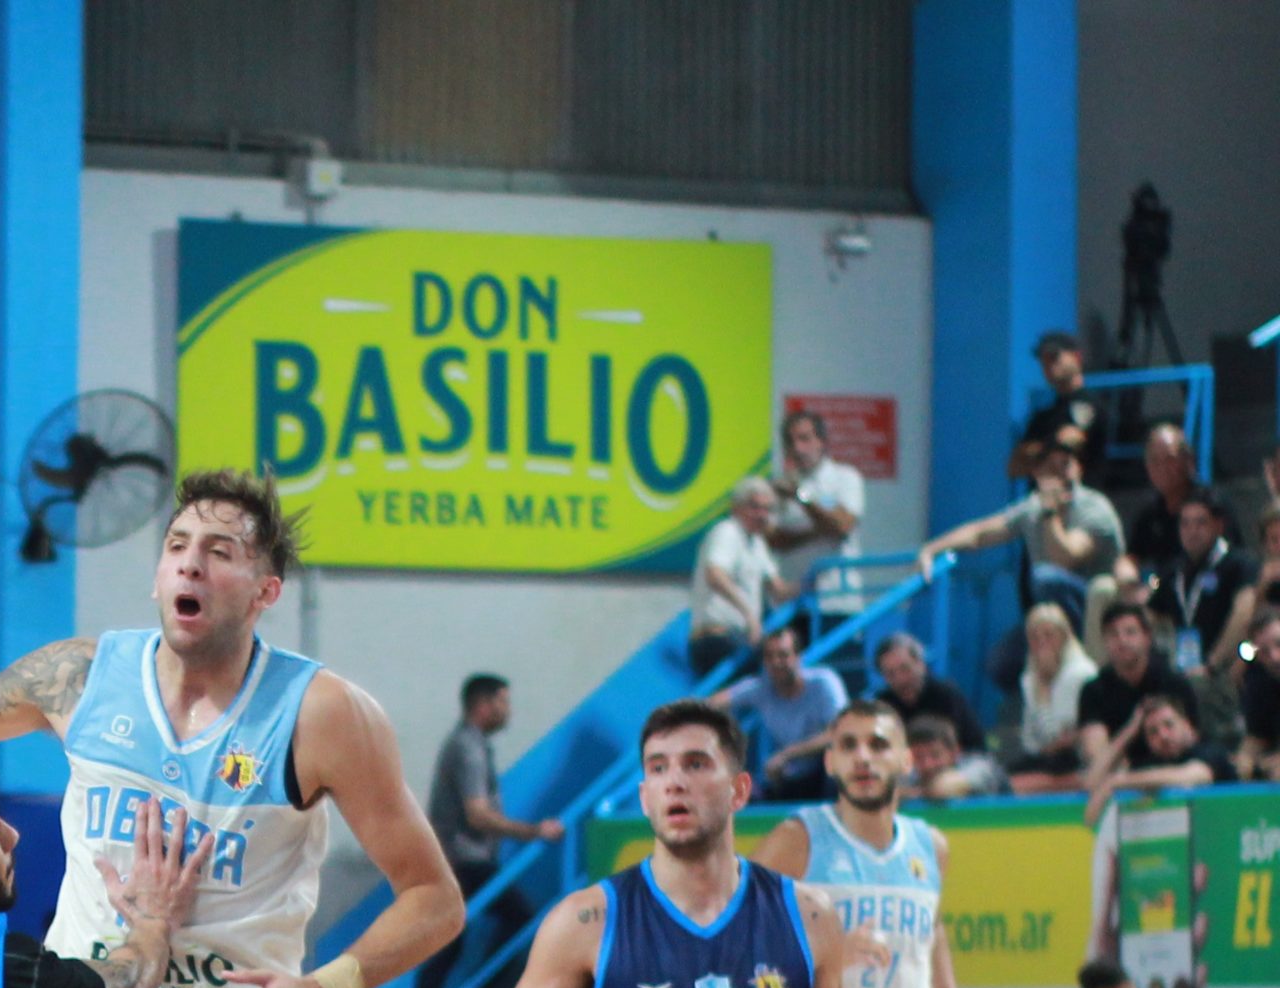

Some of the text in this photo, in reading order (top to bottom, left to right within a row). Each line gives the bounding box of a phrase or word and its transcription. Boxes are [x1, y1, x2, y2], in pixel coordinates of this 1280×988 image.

[412, 270, 559, 342] DON
[254, 339, 712, 496] BASILIO
[356, 490, 611, 531] YERBA MATE
[1233, 870, 1273, 947] EL
